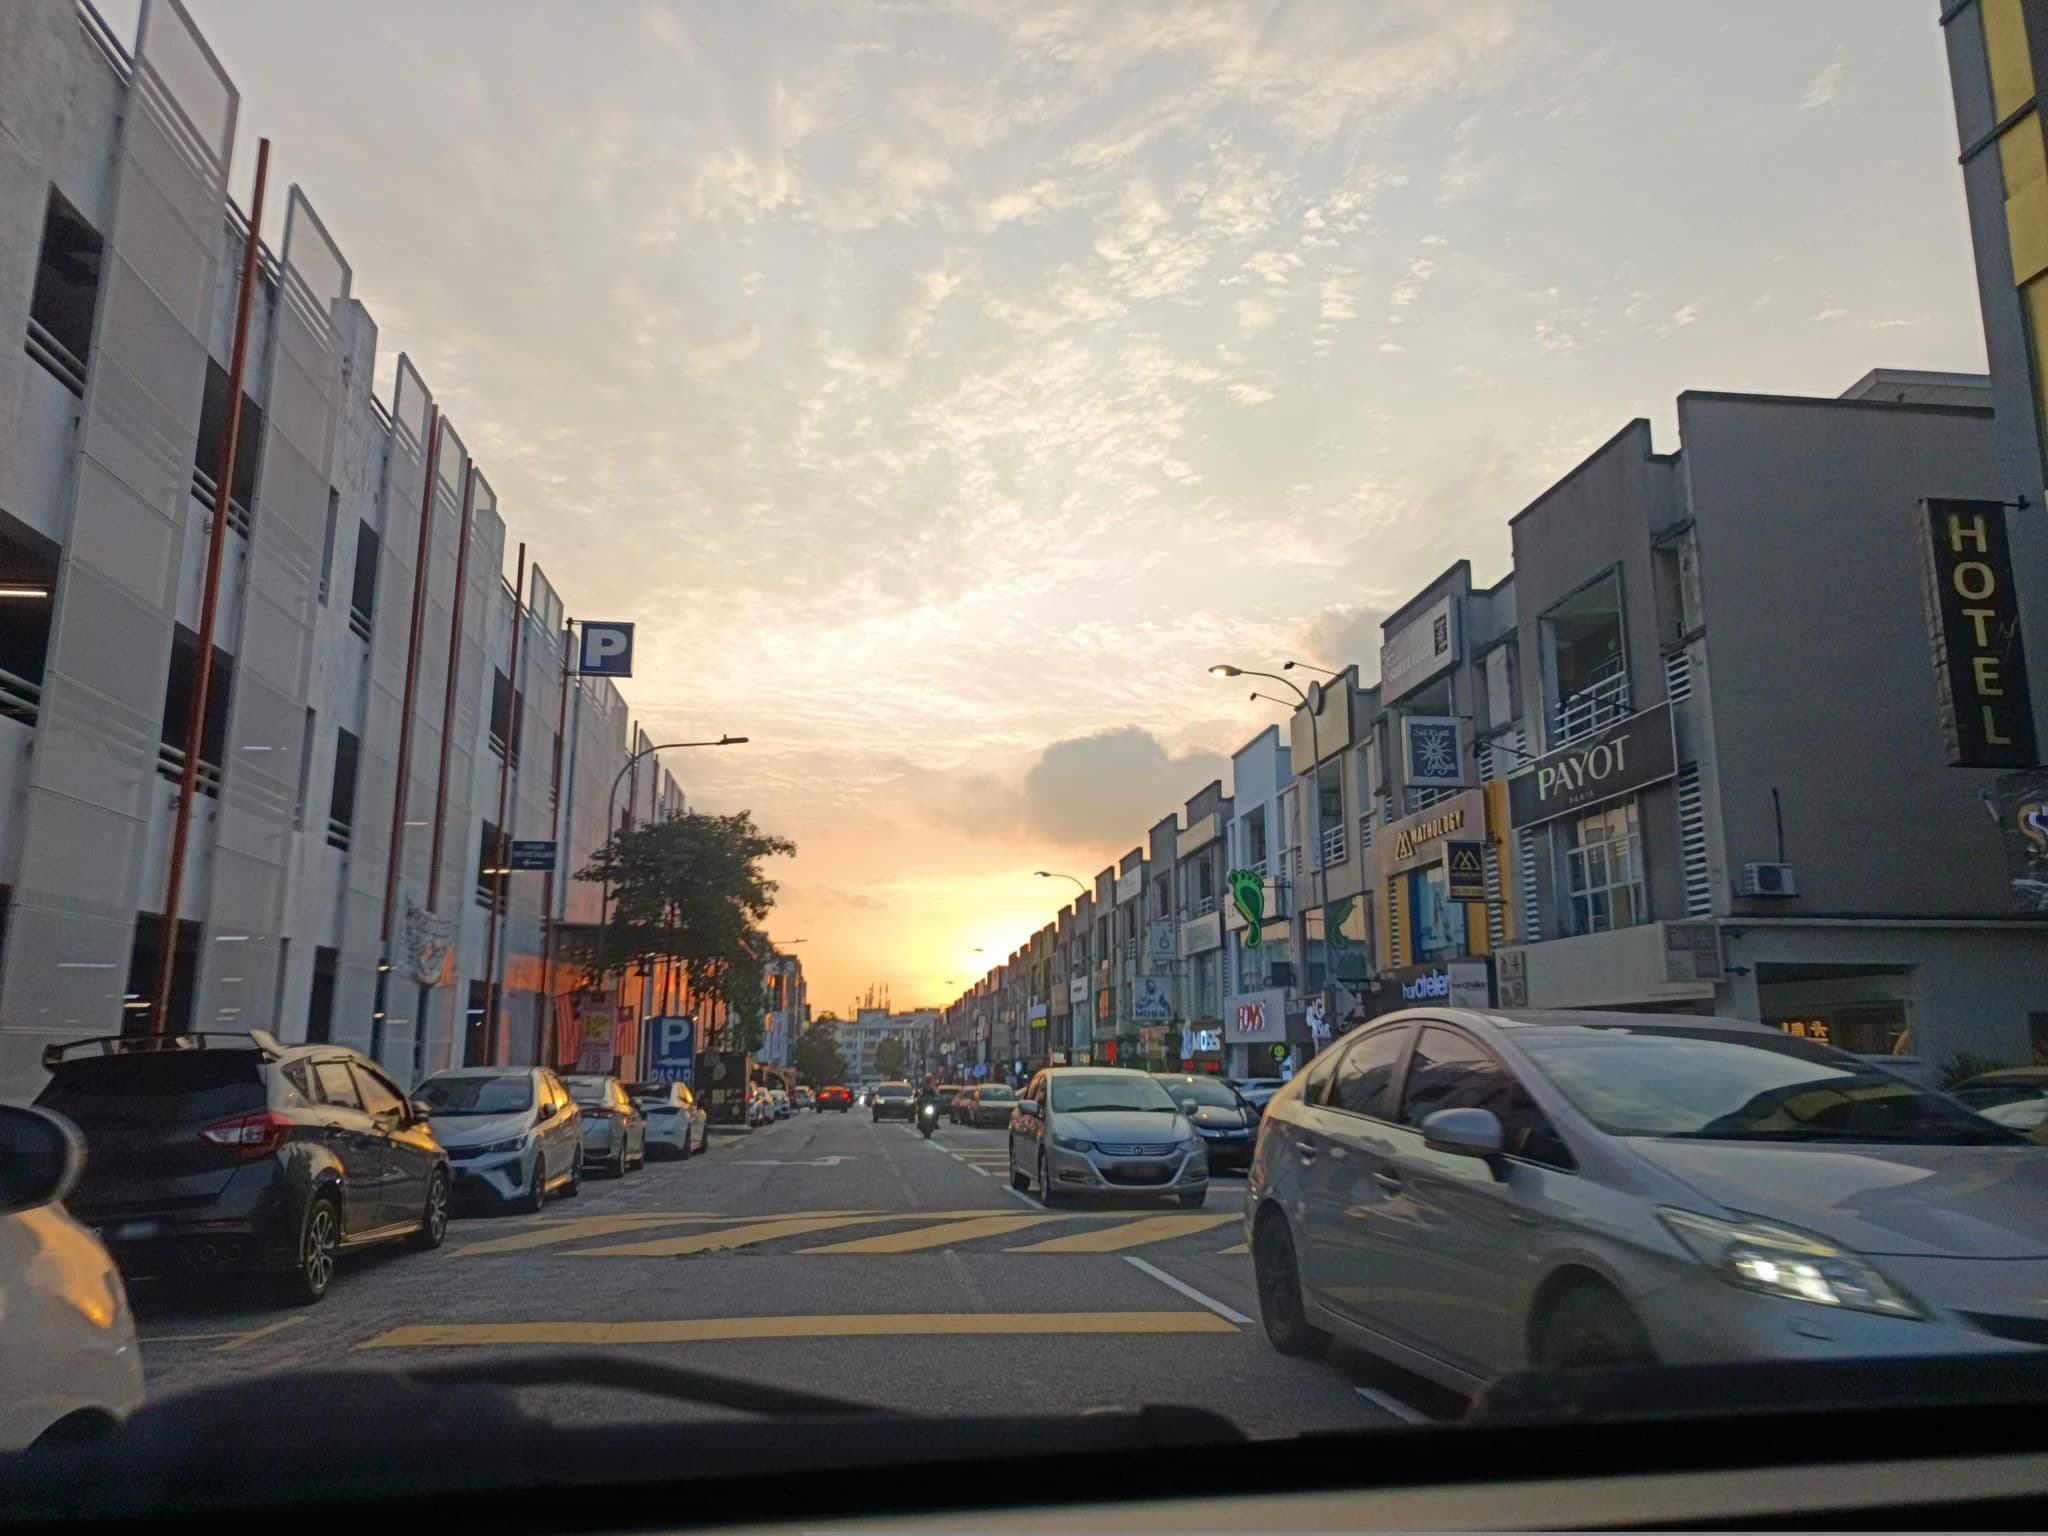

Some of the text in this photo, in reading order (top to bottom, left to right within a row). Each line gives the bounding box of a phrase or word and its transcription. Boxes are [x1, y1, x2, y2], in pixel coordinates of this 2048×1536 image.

[585, 628, 627, 667] P
[1950, 514, 2011, 745] HOTEL
[1538, 734, 1630, 800] PAYOT
[1410, 810, 1463, 846] MATHOLOGY
[661, 1019, 689, 1056] P
